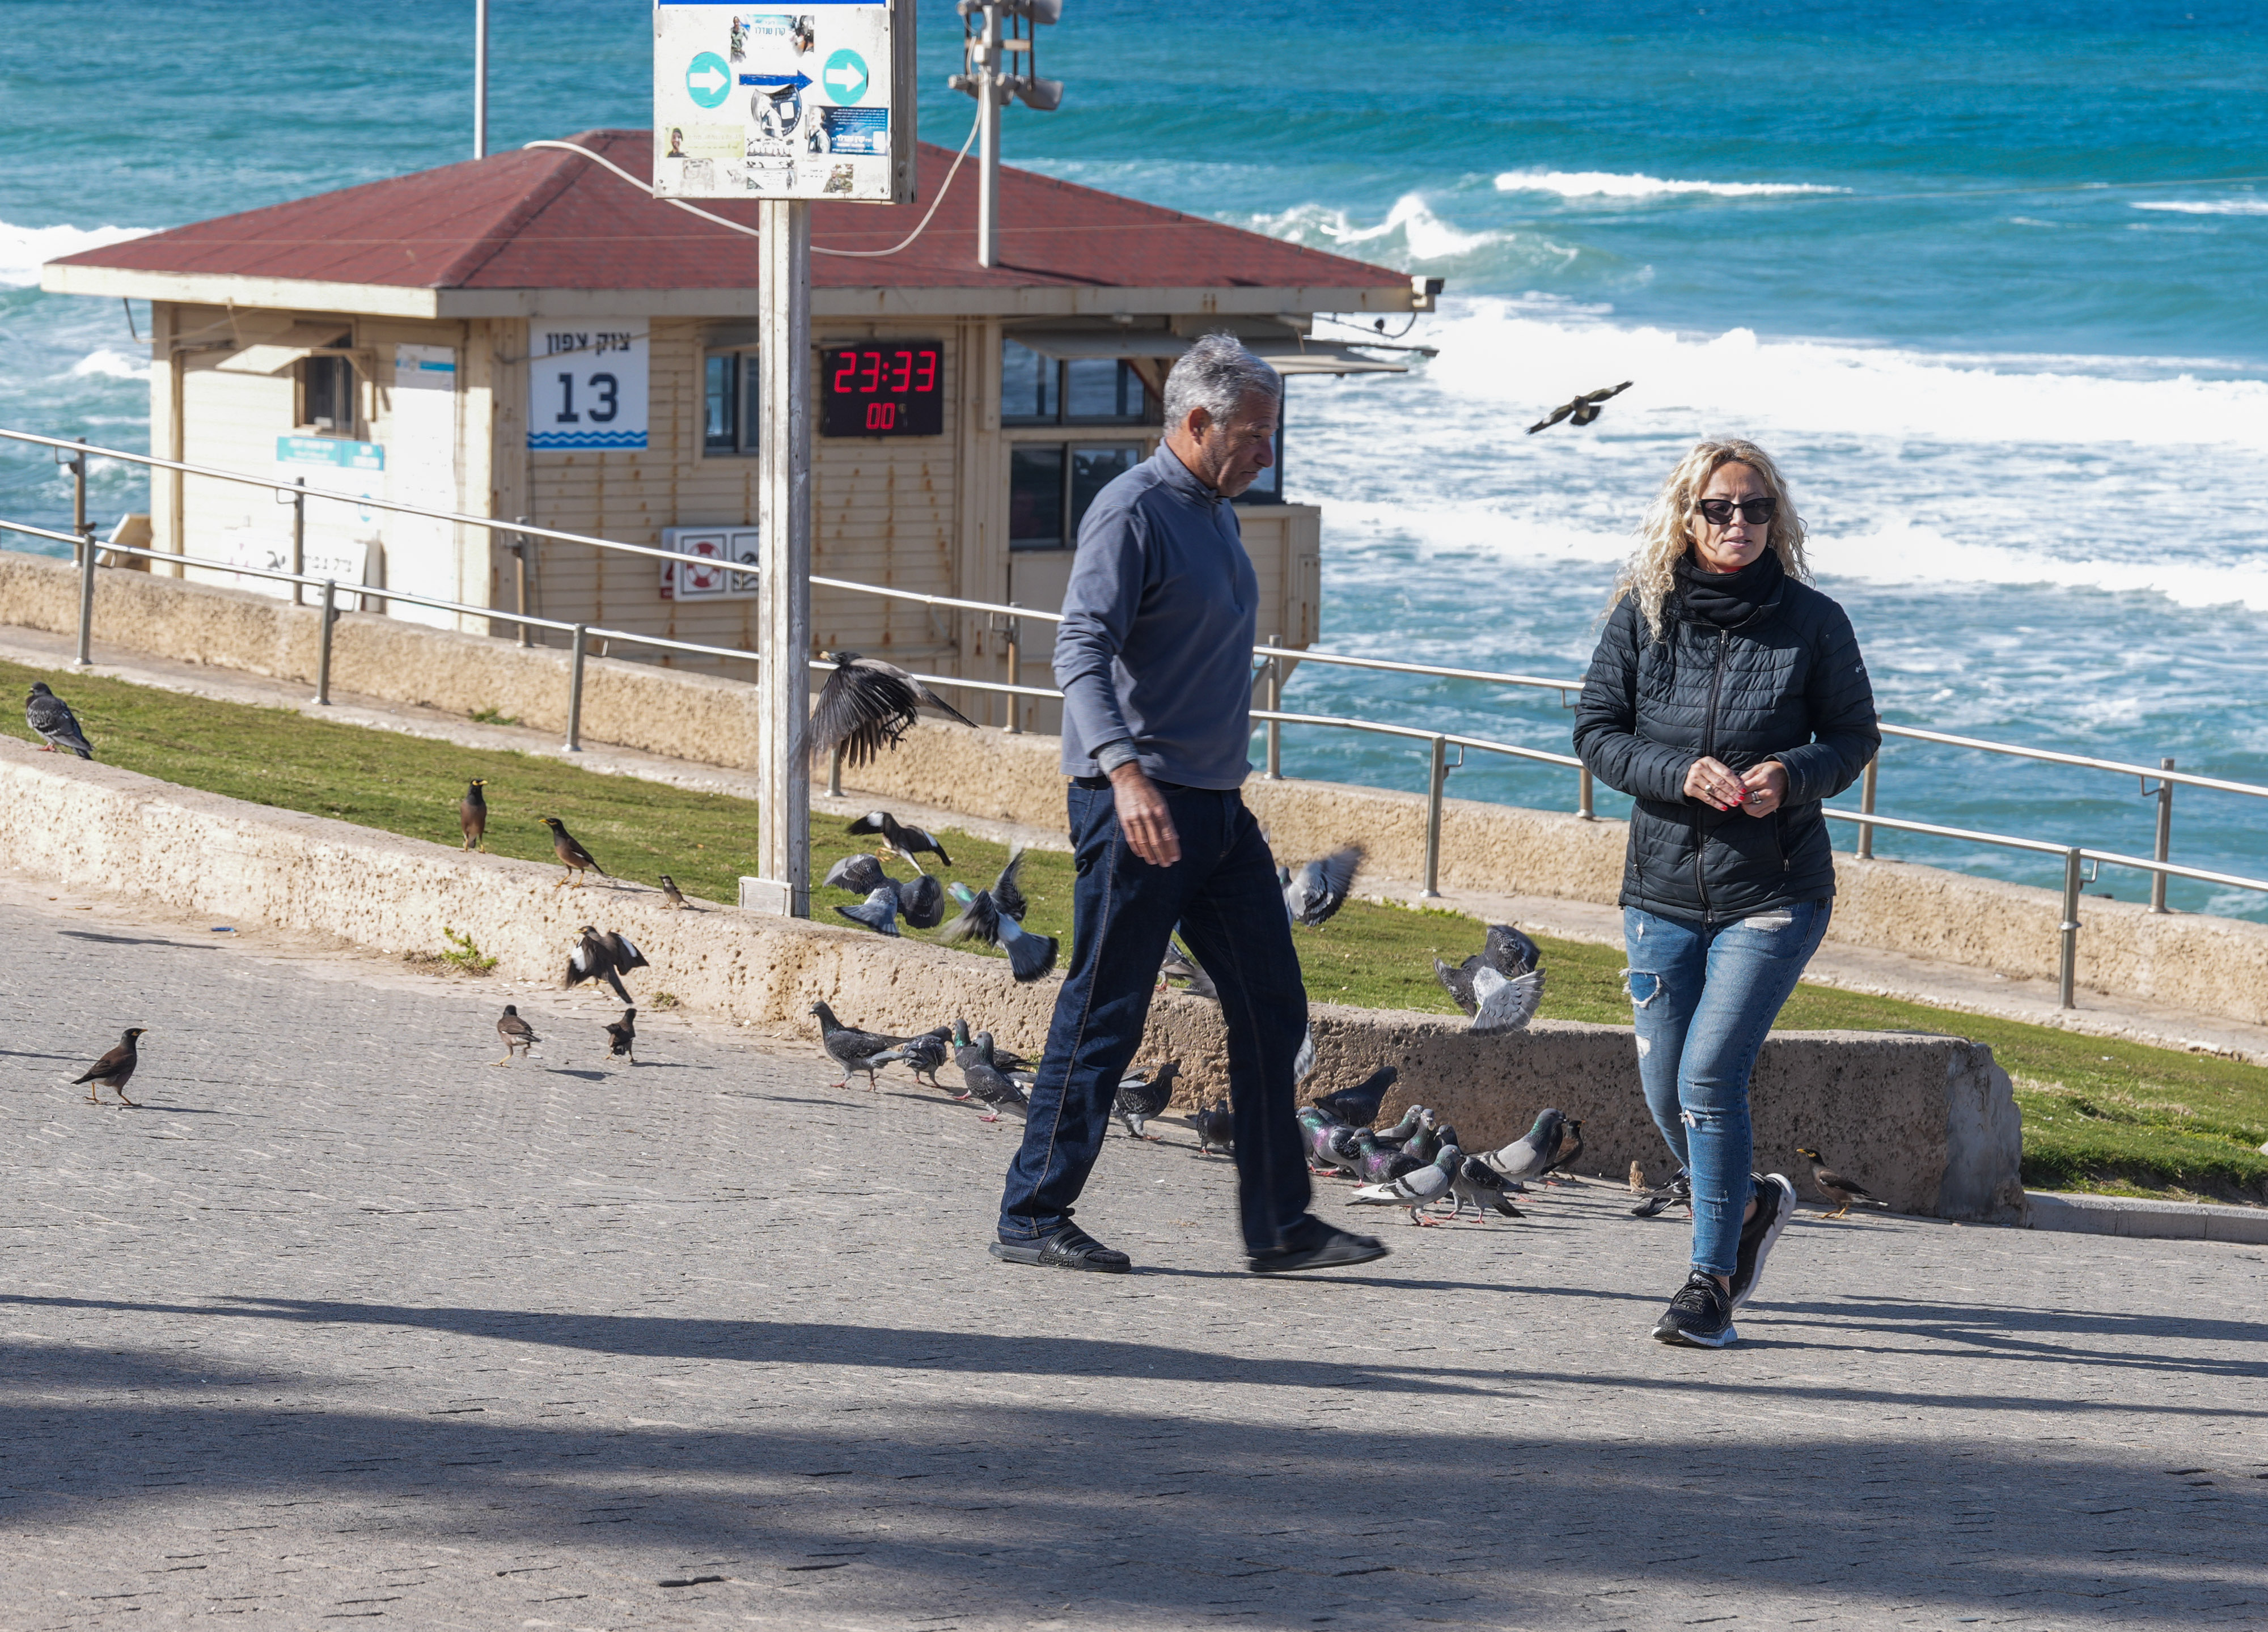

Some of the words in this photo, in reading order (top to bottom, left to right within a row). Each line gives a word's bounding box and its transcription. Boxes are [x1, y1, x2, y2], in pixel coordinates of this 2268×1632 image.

[545, 331, 589, 355] צפון
[595, 332, 631, 357] צוק
[834, 351, 937, 393] 23:33
[556, 373, 619, 423] 13
[866, 402, 895, 430] 00
[1043, 1255, 1075, 1266] adidas
